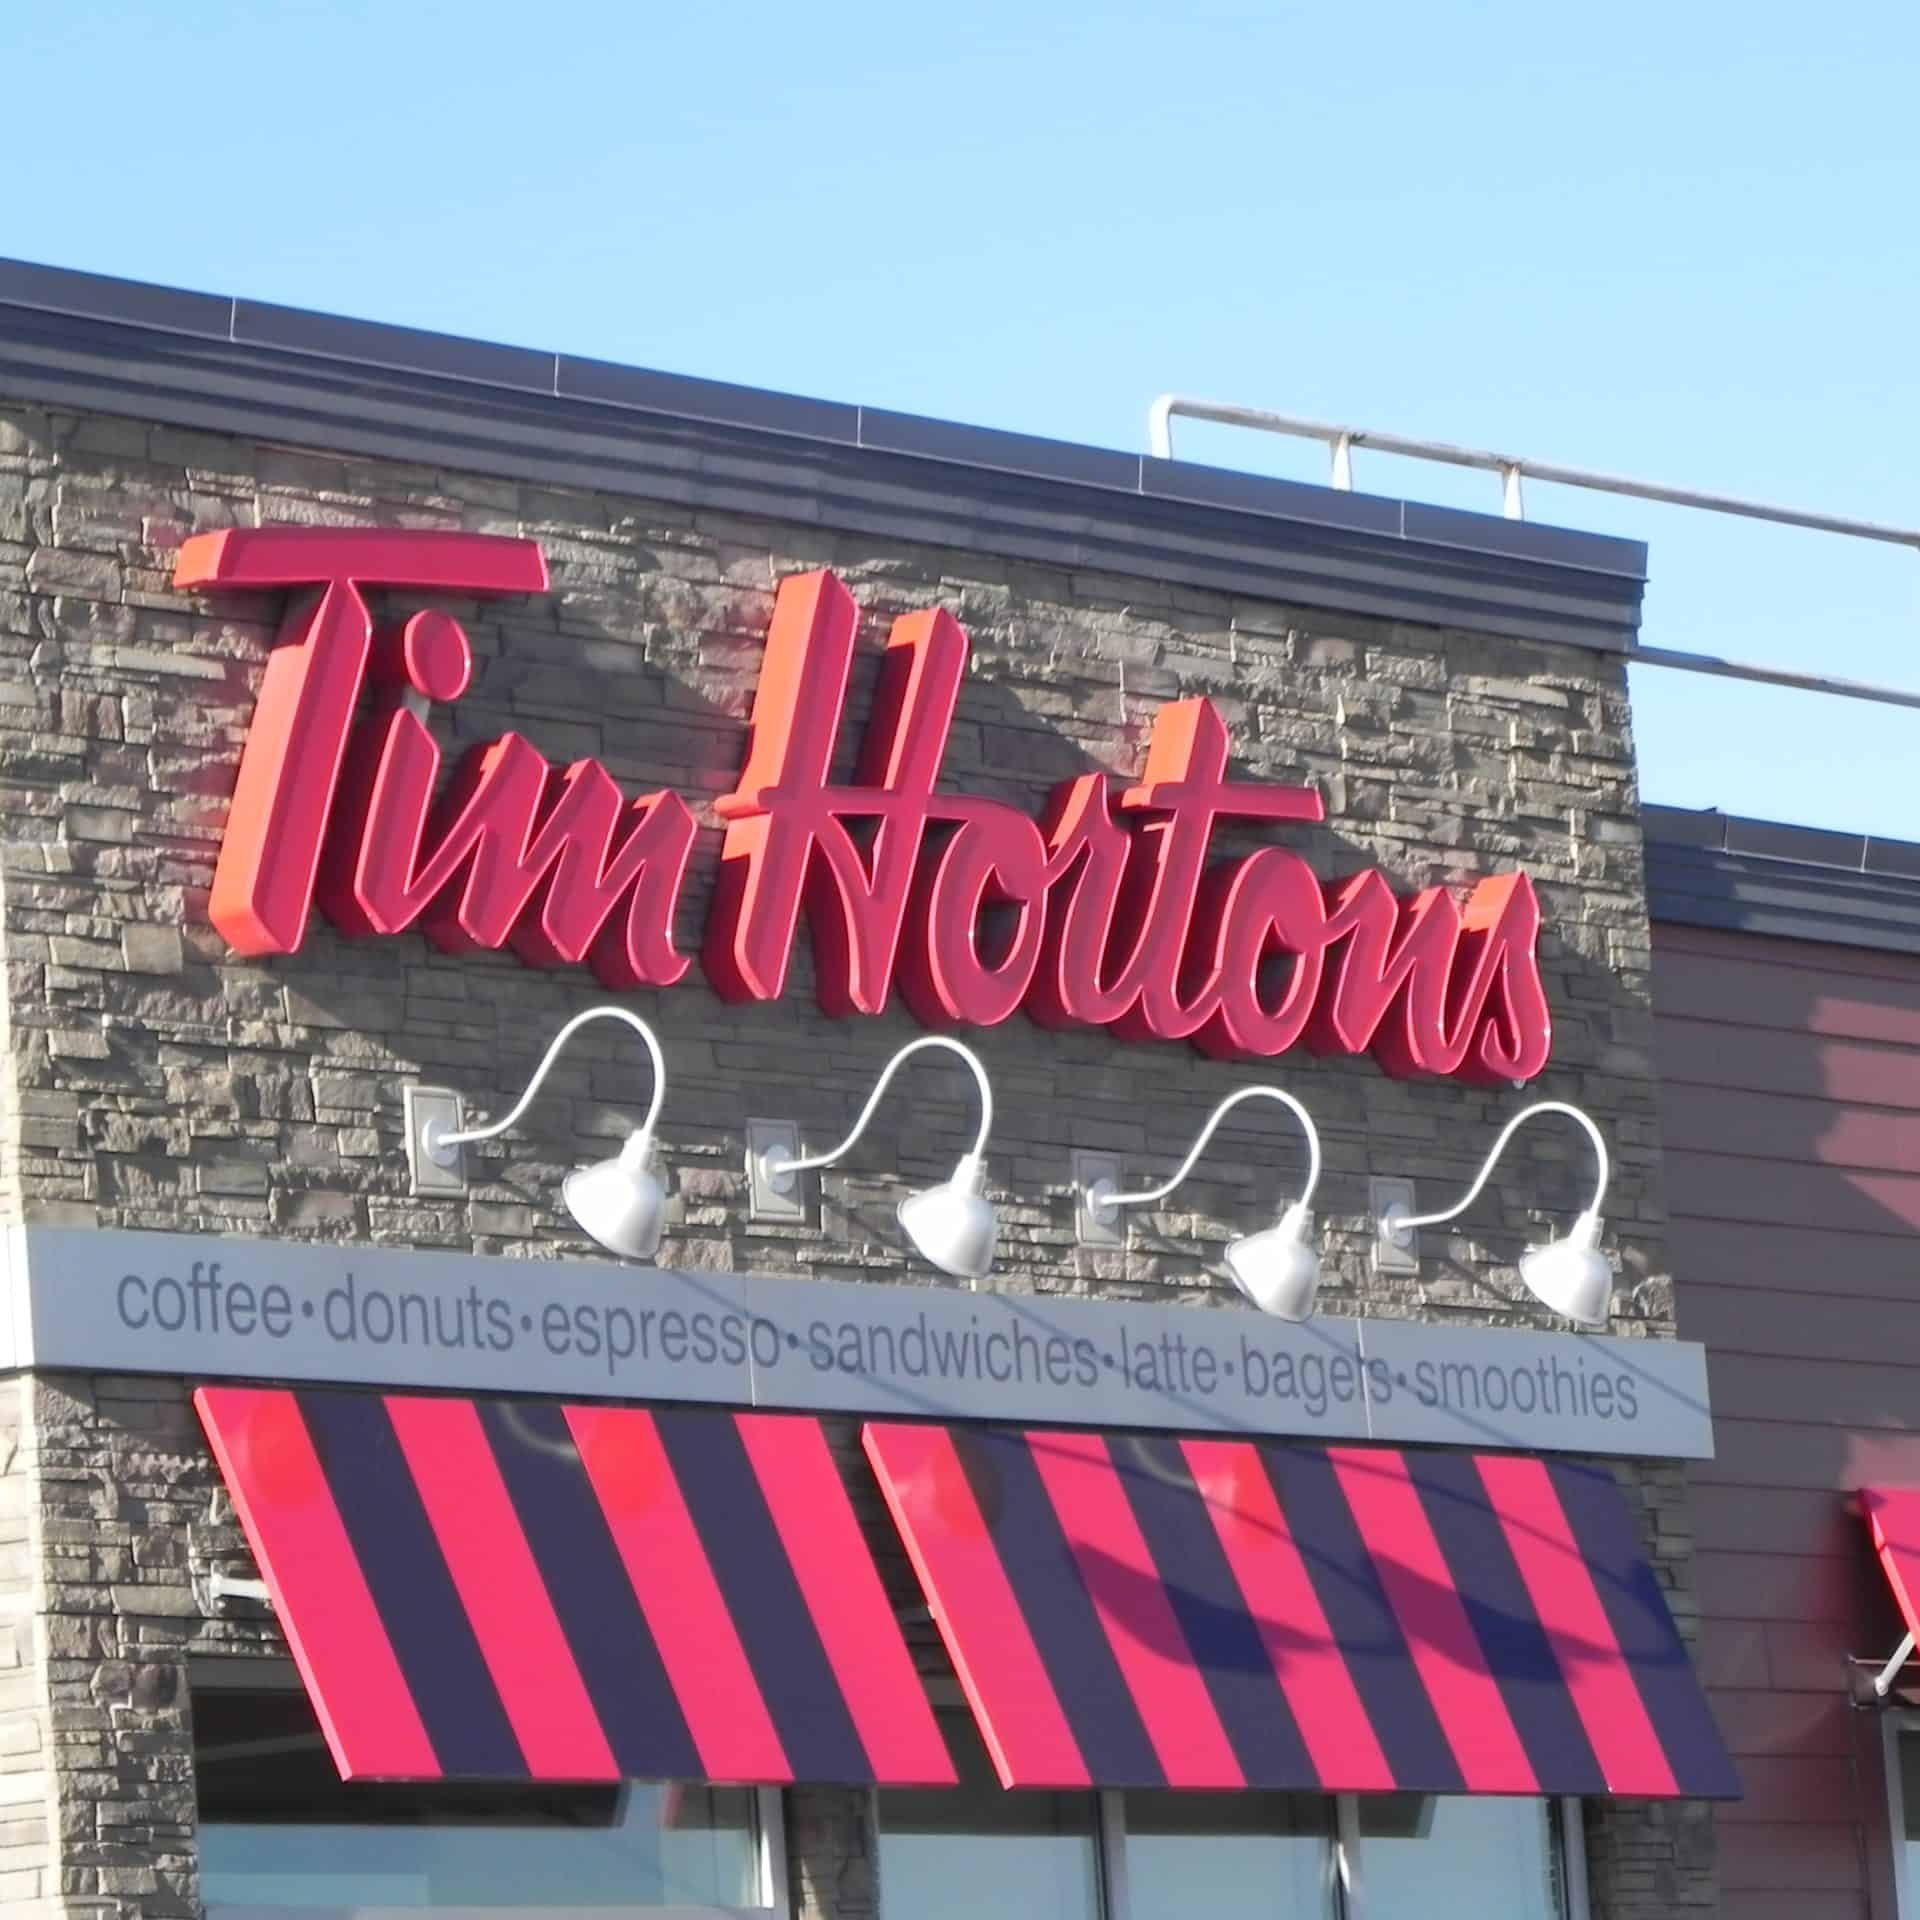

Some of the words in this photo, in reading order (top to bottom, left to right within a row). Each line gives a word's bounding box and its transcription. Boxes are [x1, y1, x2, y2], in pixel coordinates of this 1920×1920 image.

[173, 527, 698, 986] Tim
[710, 569, 1553, 1084] Hortons
[117, 1261, 292, 1338] coffee
[323, 1272, 514, 1353] donuts
[542, 1300, 780, 1377] espresso
[809, 1312, 1099, 1387] sandwiches
[1120, 1323, 1218, 1395] latte
[1241, 1331, 1393, 1418] bagels
[1416, 1355, 1639, 1420] smoothies
